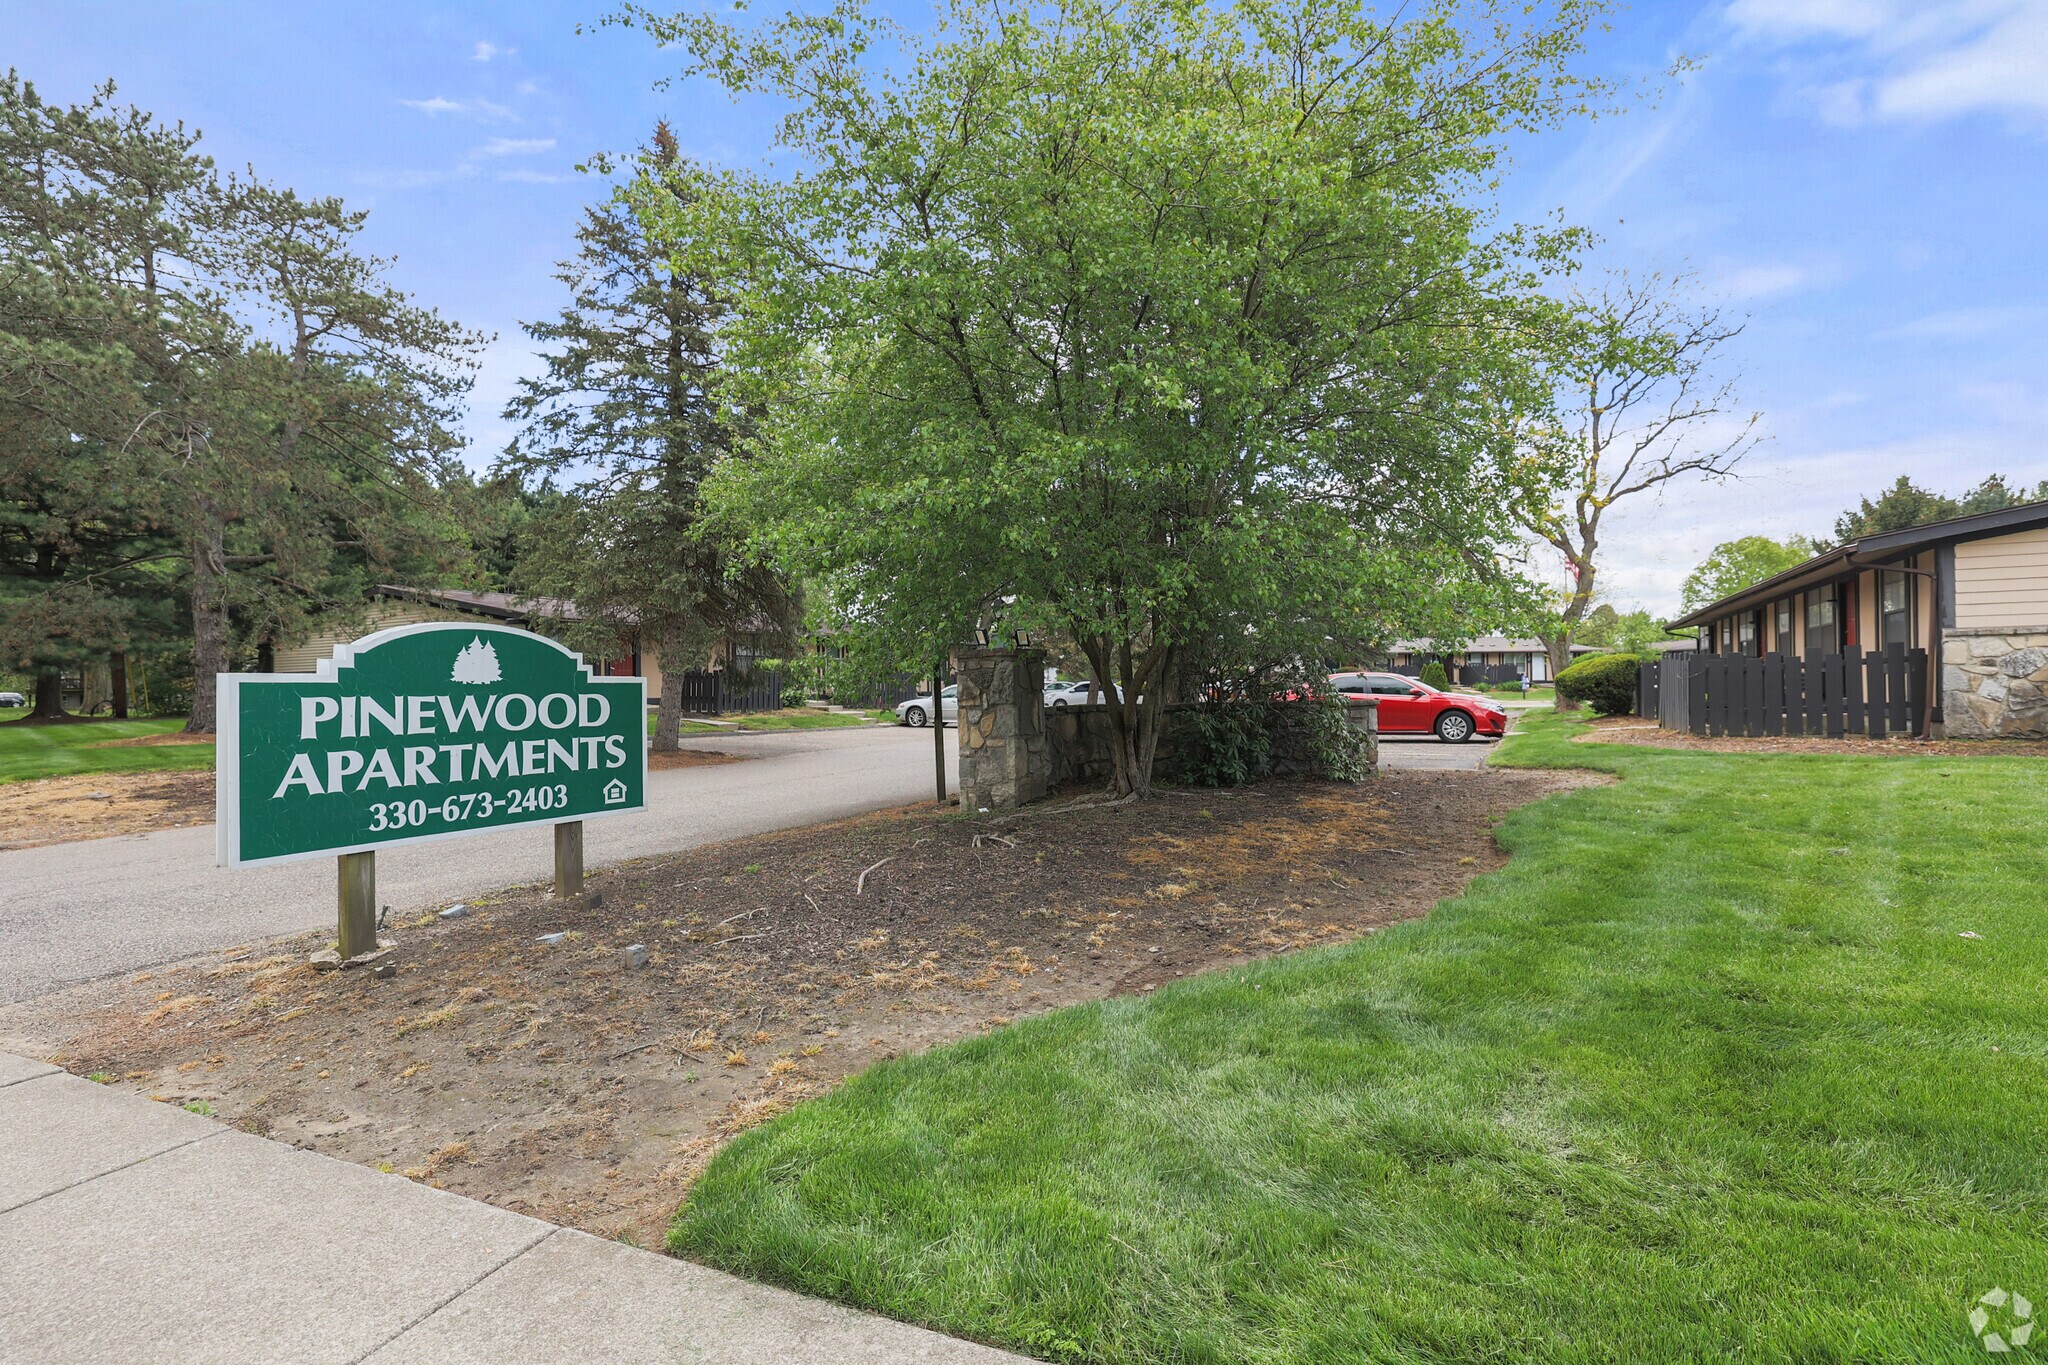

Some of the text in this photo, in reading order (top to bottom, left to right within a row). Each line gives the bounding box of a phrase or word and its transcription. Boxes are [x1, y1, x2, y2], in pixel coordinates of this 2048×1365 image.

[300, 693, 611, 739] PINEWOOD
[272, 734, 627, 799] APARTMENTS
[369, 784, 568, 831] 330-673-2403
